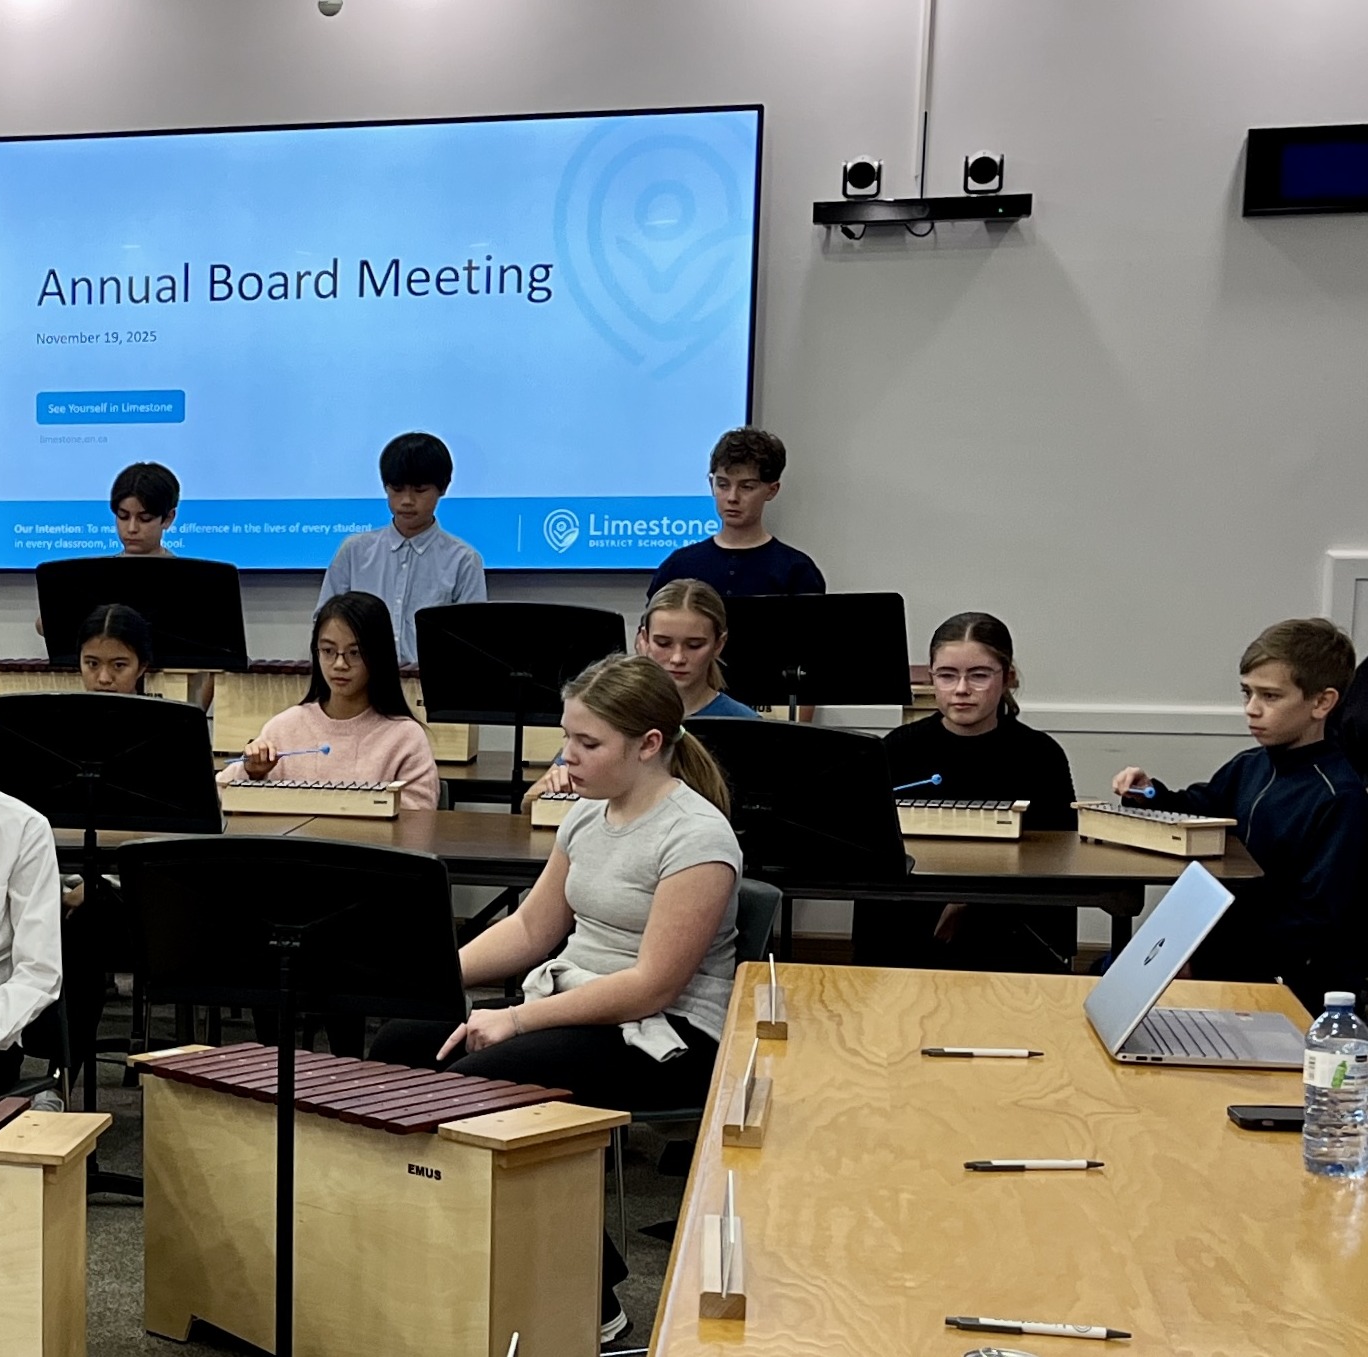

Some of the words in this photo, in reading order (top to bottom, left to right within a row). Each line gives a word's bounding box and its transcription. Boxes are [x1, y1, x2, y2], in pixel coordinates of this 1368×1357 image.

[37, 262, 190, 307] Annual
[209, 257, 339, 302] Board
[358, 254, 554, 303] Meeting
[36, 332, 101, 345] November
[104, 331, 123, 345] 19,
[126, 330, 157, 343] 2025
[48, 403, 66, 414] See
[68, 402, 108, 414] Yourself
[109, 403, 119, 413] in
[121, 402, 173, 413] Limestone
[14, 524, 33, 534] Our
[87, 523, 98, 534] To
[179, 522, 230, 533] difference
[232, 523, 241, 533] in
[244, 522, 261, 533] the
[264, 522, 285, 533] lives
[288, 522, 301, 533] of
[302, 524, 331, 535] every
[332, 522, 372, 533] student
[589, 513, 719, 536] Limestone
[14, 539, 24, 548] in
[26, 540, 52, 550] every
[54, 538, 107, 550] classroom,
[109, 538, 119, 548] in
[589, 539, 633, 548] DISTRICT
[637, 539, 679, 548] SCHOOL
[407, 1163, 441, 1181] EMUS
